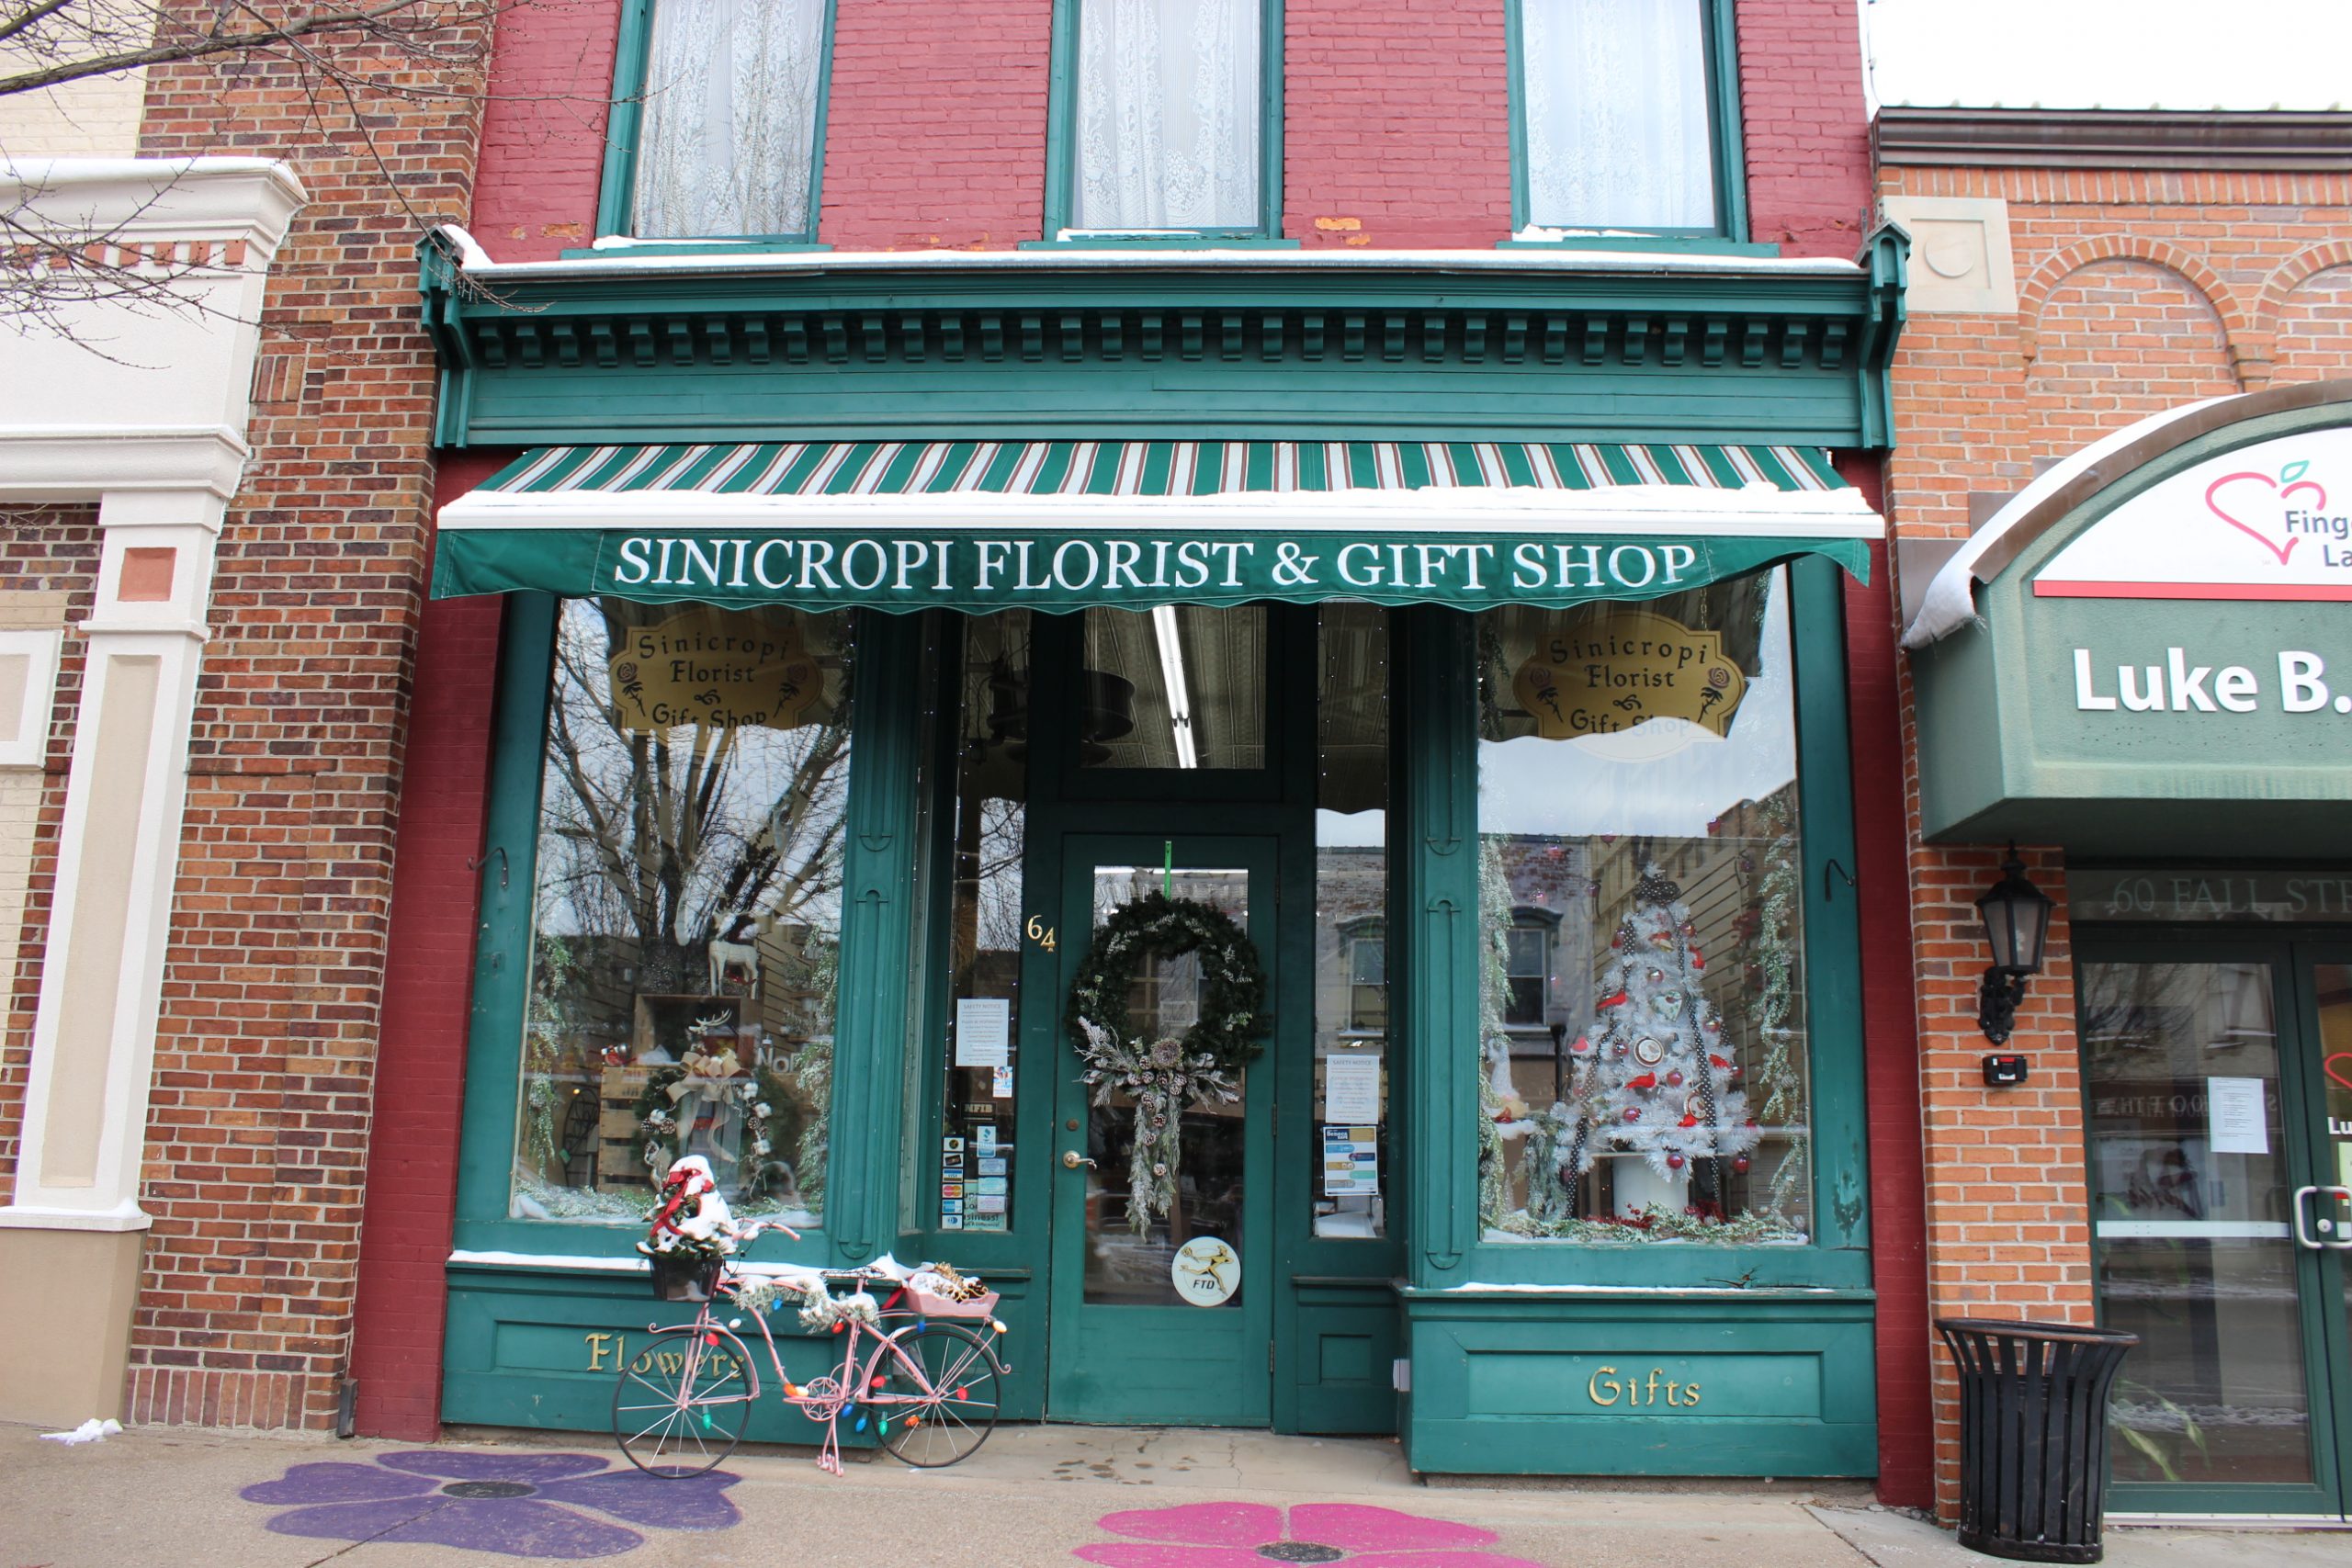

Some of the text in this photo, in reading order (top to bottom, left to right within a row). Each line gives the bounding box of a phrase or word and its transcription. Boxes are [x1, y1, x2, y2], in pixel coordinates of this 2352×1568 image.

[2285, 510, 2352, 540] Fing
[615, 537, 1696, 590] SINICROPI FLORIST & GIFT SHOP
[639, 632, 788, 664] Sinicropi
[1549, 636, 1707, 669] Sinicropi
[670, 660, 755, 683] Florist
[1584, 664, 1675, 688] Florist
[2074, 647, 2352, 713] Luke B.
[652, 703, 767, 730] Gift Shop
[1570, 708, 1618, 734] Gift
[2114, 878, 2155, 912] 60
[2169, 878, 2268, 913] FALL
[1027, 914, 1056, 953] 64
[1193, 1279, 1216, 1290] FTD
[1589, 1366, 1701, 1406] Gifts
